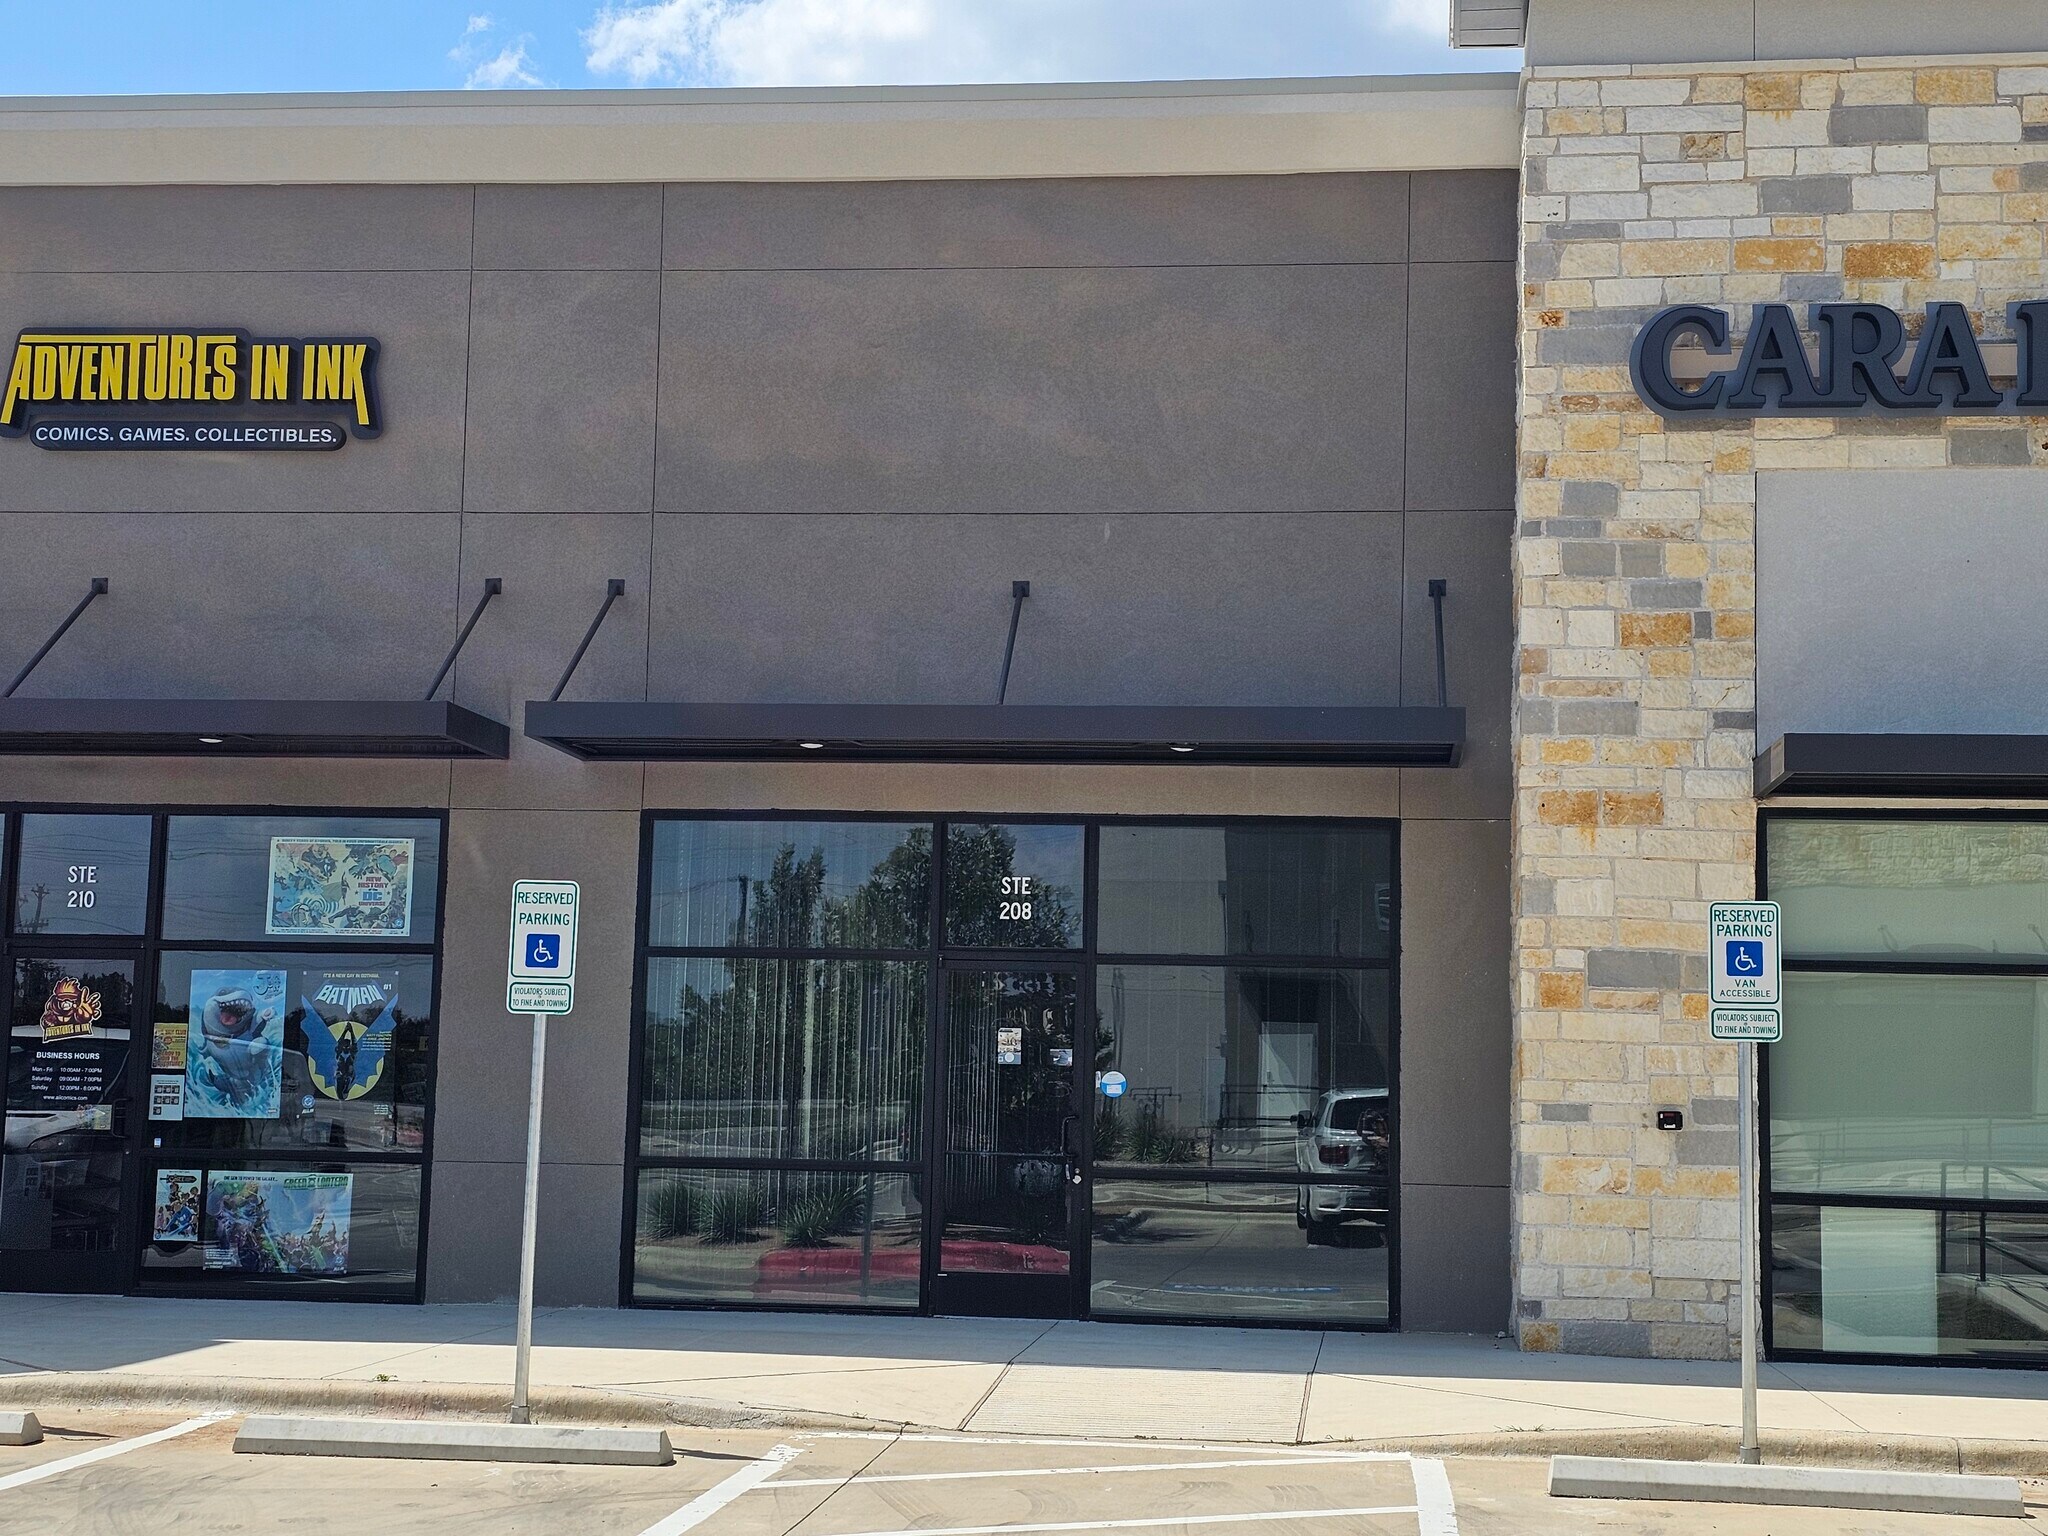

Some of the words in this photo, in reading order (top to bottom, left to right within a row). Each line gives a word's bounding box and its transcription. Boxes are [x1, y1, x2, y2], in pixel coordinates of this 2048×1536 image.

[0, 335, 237, 424] ADVENTURES
[250, 345, 289, 400] IN
[302, 344, 370, 425] INK
[35, 427, 114, 441] COMICS.
[119, 427, 190, 442] GAMES.
[195, 428, 337, 443] COLLECTIBLES.
[67, 866, 97, 883] STE
[1001, 877, 1031, 894] STE
[67, 890, 94, 908] 210
[363, 892, 382, 900] DC
[517, 892, 573, 905] RESERVED
[1000, 902, 1031, 920] 208
[1714, 910, 1775, 922] RESERVED
[519, 913, 570, 925] PARKING
[1716, 925, 1772, 937] PARKING
[1734, 979, 1756, 987] VAN
[544, 988, 567, 996] SUBJECT
[1720, 989, 1771, 997] ACCESSIBLE
[315, 985, 384, 1015] BATMAN
[533, 999, 545, 1007] AND
[546, 999, 567, 1007] TOWING
[1716, 1014, 1748, 1022] VIOLATORS
[1750, 1014, 1774, 1022] SUBJECT
[1739, 1026, 1751, 1034] AND
[1753, 1026, 1776, 1034] TOWING
[284, 1178, 307, 1189] GREEN
[317, 1176, 348, 1188] LANTERN
